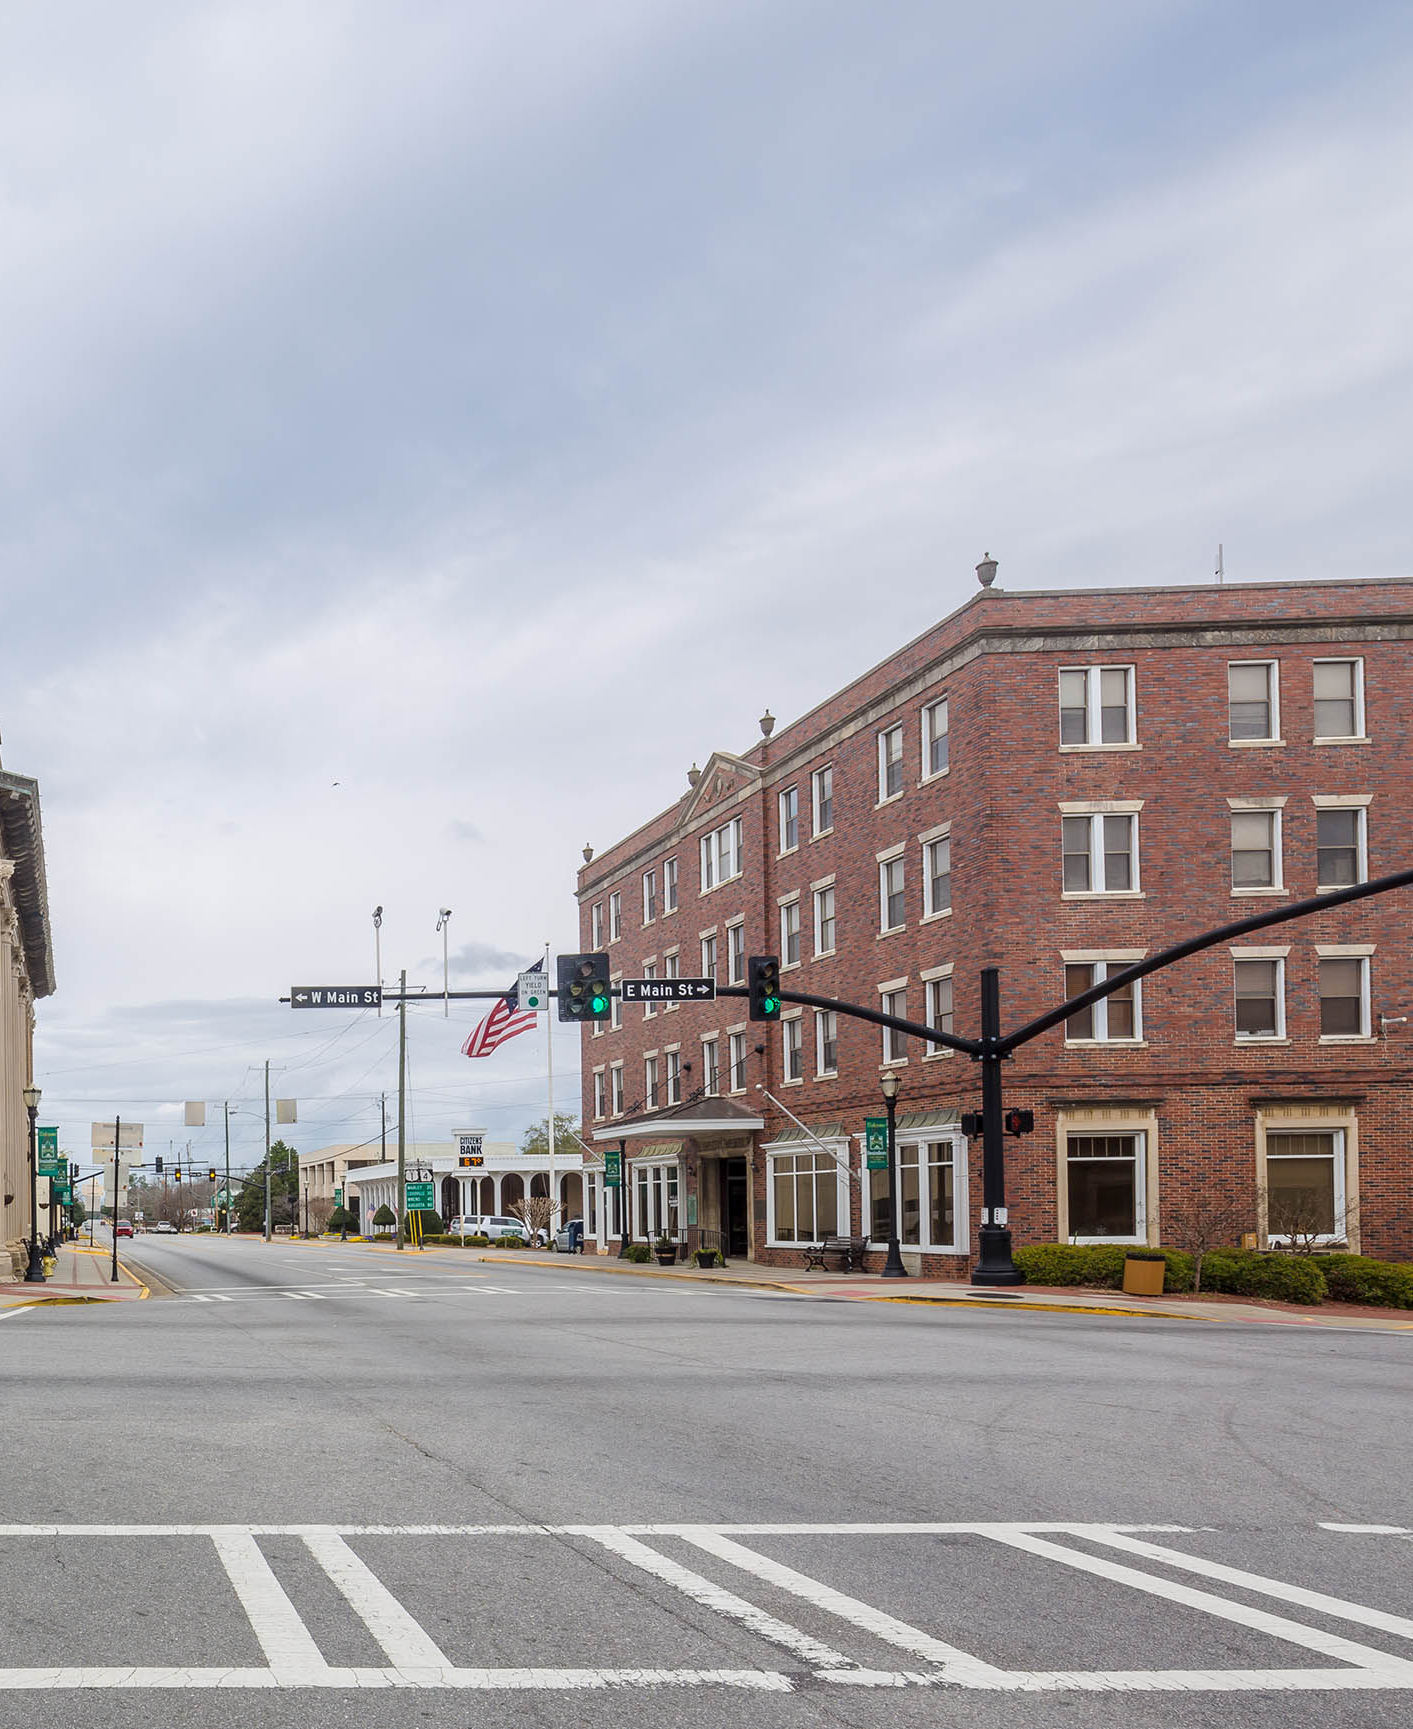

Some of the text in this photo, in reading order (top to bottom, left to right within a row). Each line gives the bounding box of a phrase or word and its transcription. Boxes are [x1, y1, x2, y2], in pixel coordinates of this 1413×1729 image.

[627, 983, 693, 997] E Main St
[311, 991, 378, 1003] W Main St
[459, 1136, 483, 1145] CITIZENS
[460, 1145, 483, 1154] BANK
